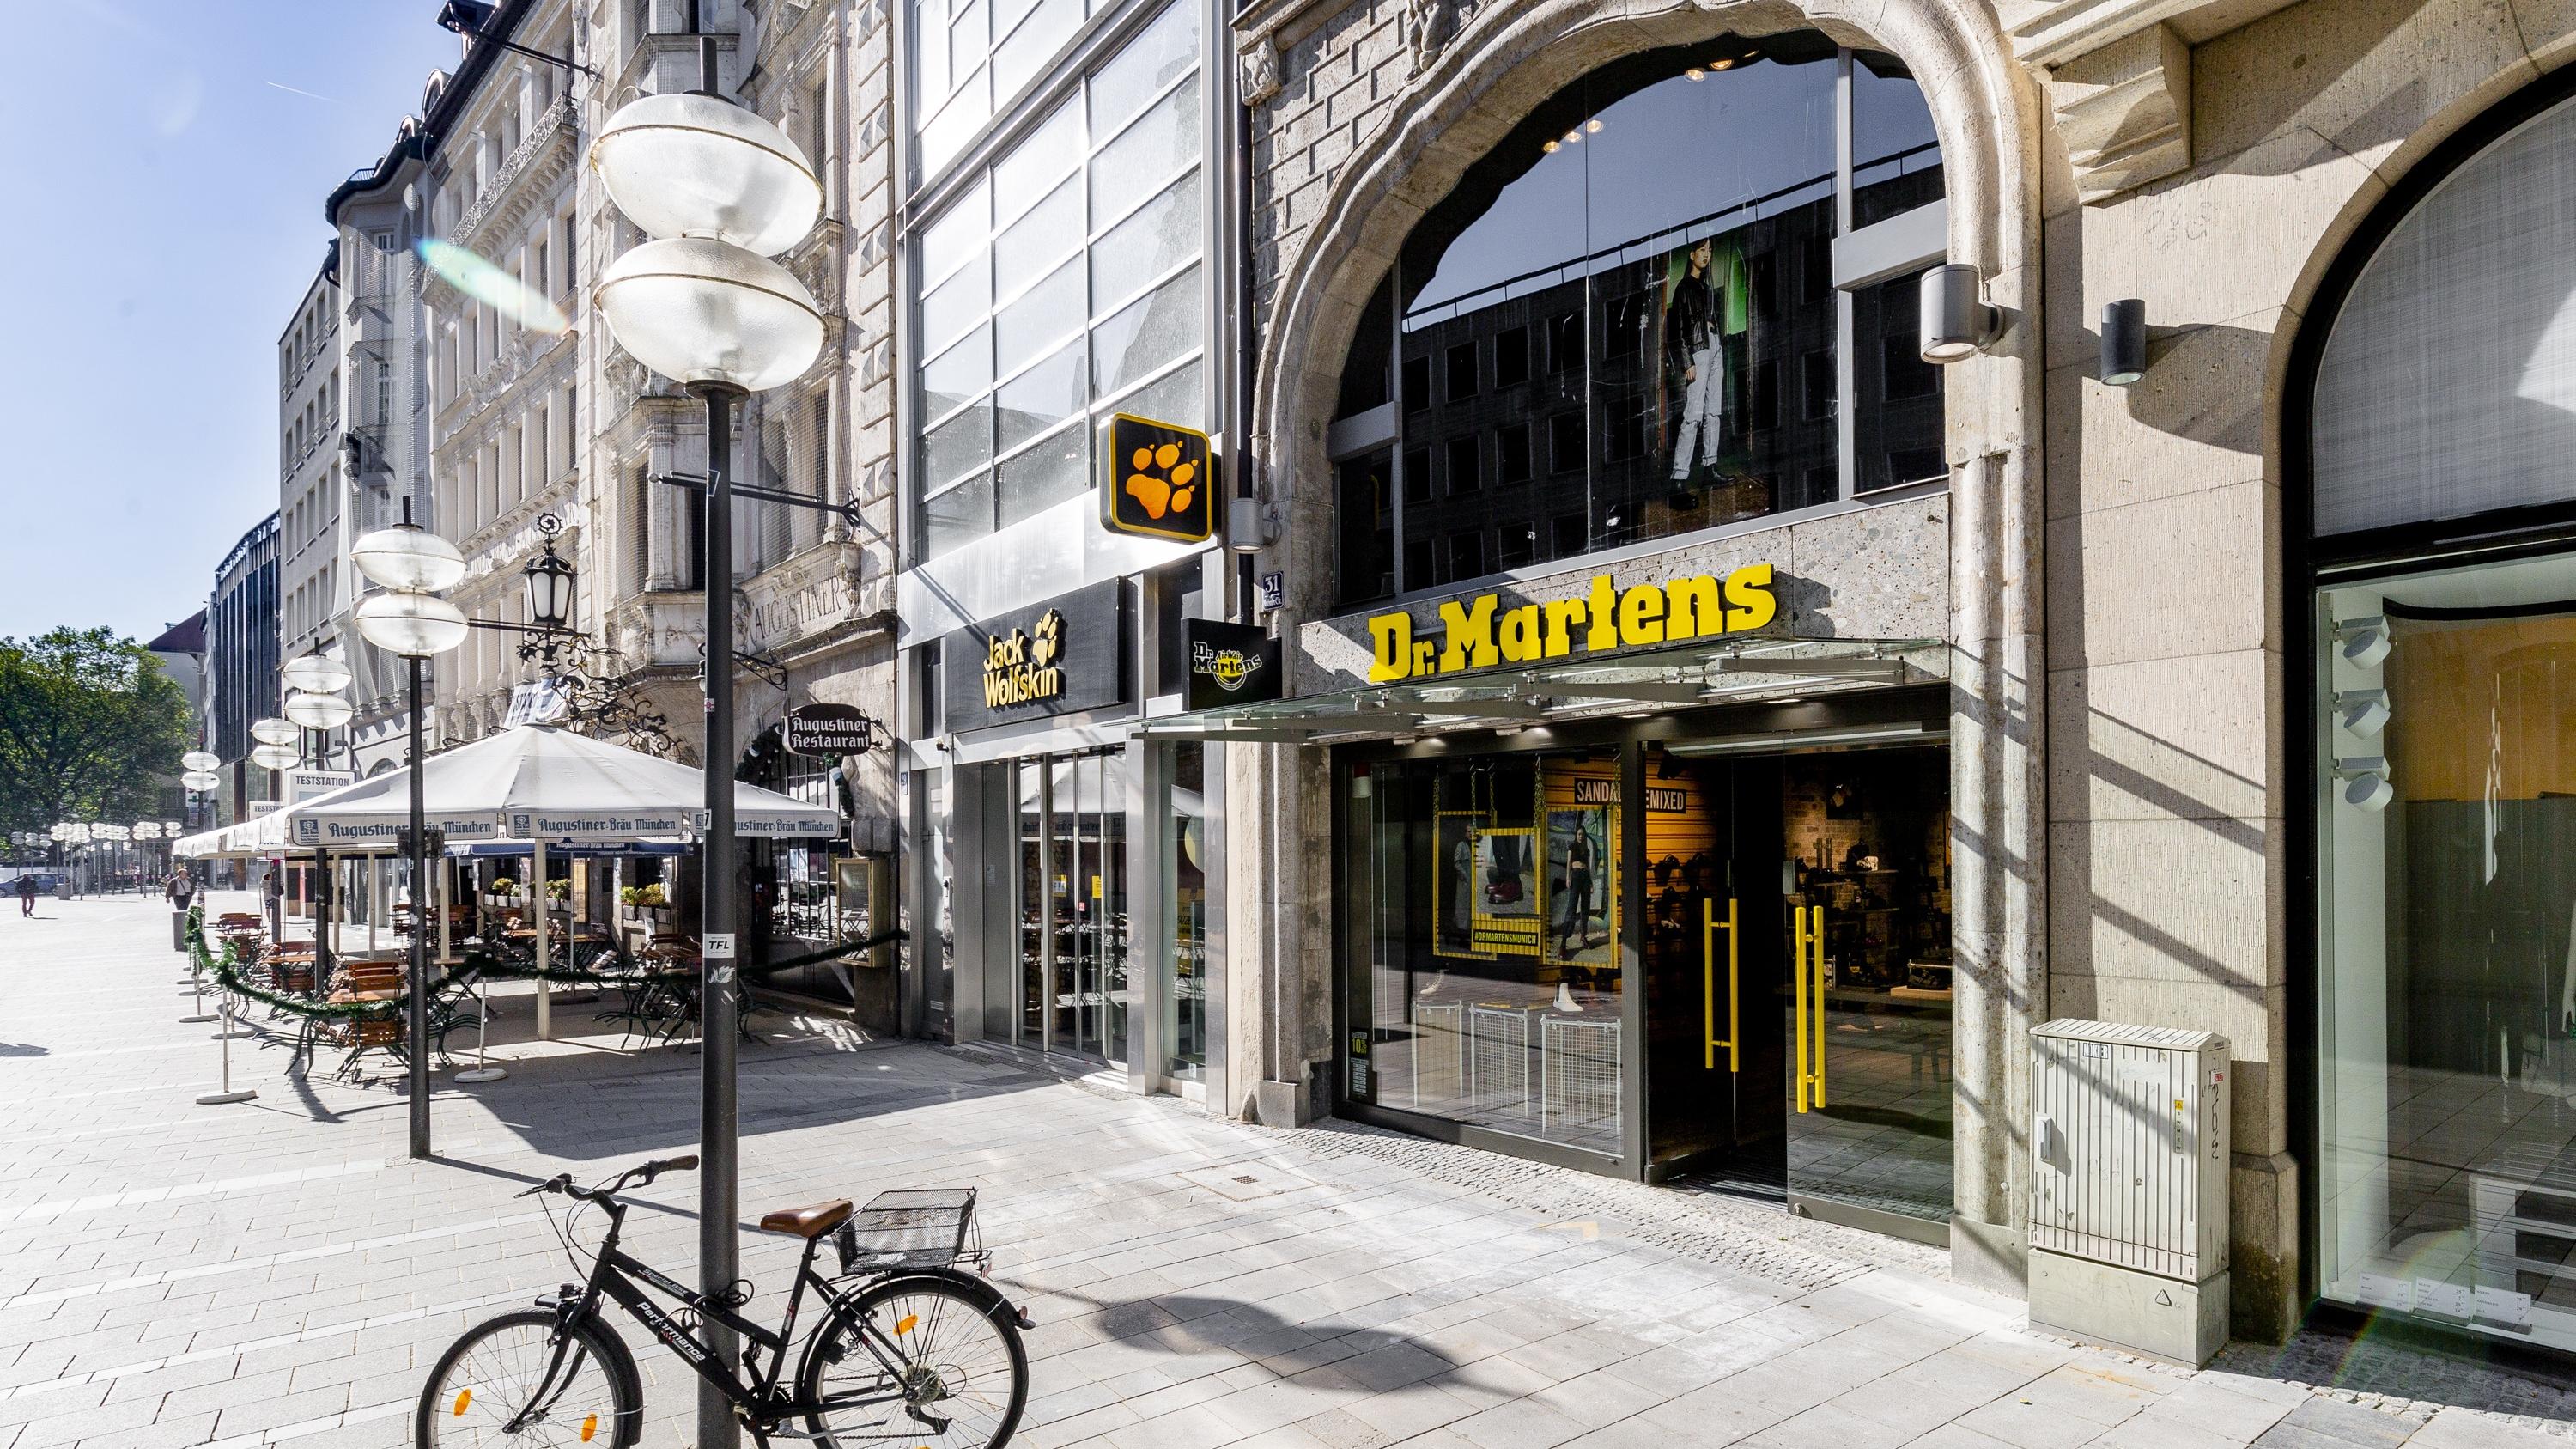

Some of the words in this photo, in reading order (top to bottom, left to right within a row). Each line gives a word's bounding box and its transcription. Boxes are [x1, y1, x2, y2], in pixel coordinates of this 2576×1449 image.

[1264, 575, 1279, 593] 31
[756, 575, 841, 639] AUGUSTINER
[1439, 563, 1777, 673] Martens
[983, 627, 1025, 672] Jack
[1194, 641, 1214, 659] Dr.
[1194, 654, 1263, 674] Martens
[982, 662, 1058, 709] Wolfskin
[791, 717, 868, 734] Augustiner
[791, 734, 871, 748] Restaurant
[295, 776, 349, 787] TESTSTATION
[1577, 780, 1621, 802] SANDAL
[1645, 789, 1684, 810] EMIXED
[442, 819, 491, 834] München
[635, 818, 676, 831] München
[799, 819, 834, 832] München
[708, 941, 730, 950] TFL
[1474, 931, 1537, 945] #DRMARTENSMUNICH
[643, 1269, 671, 1287] Special
